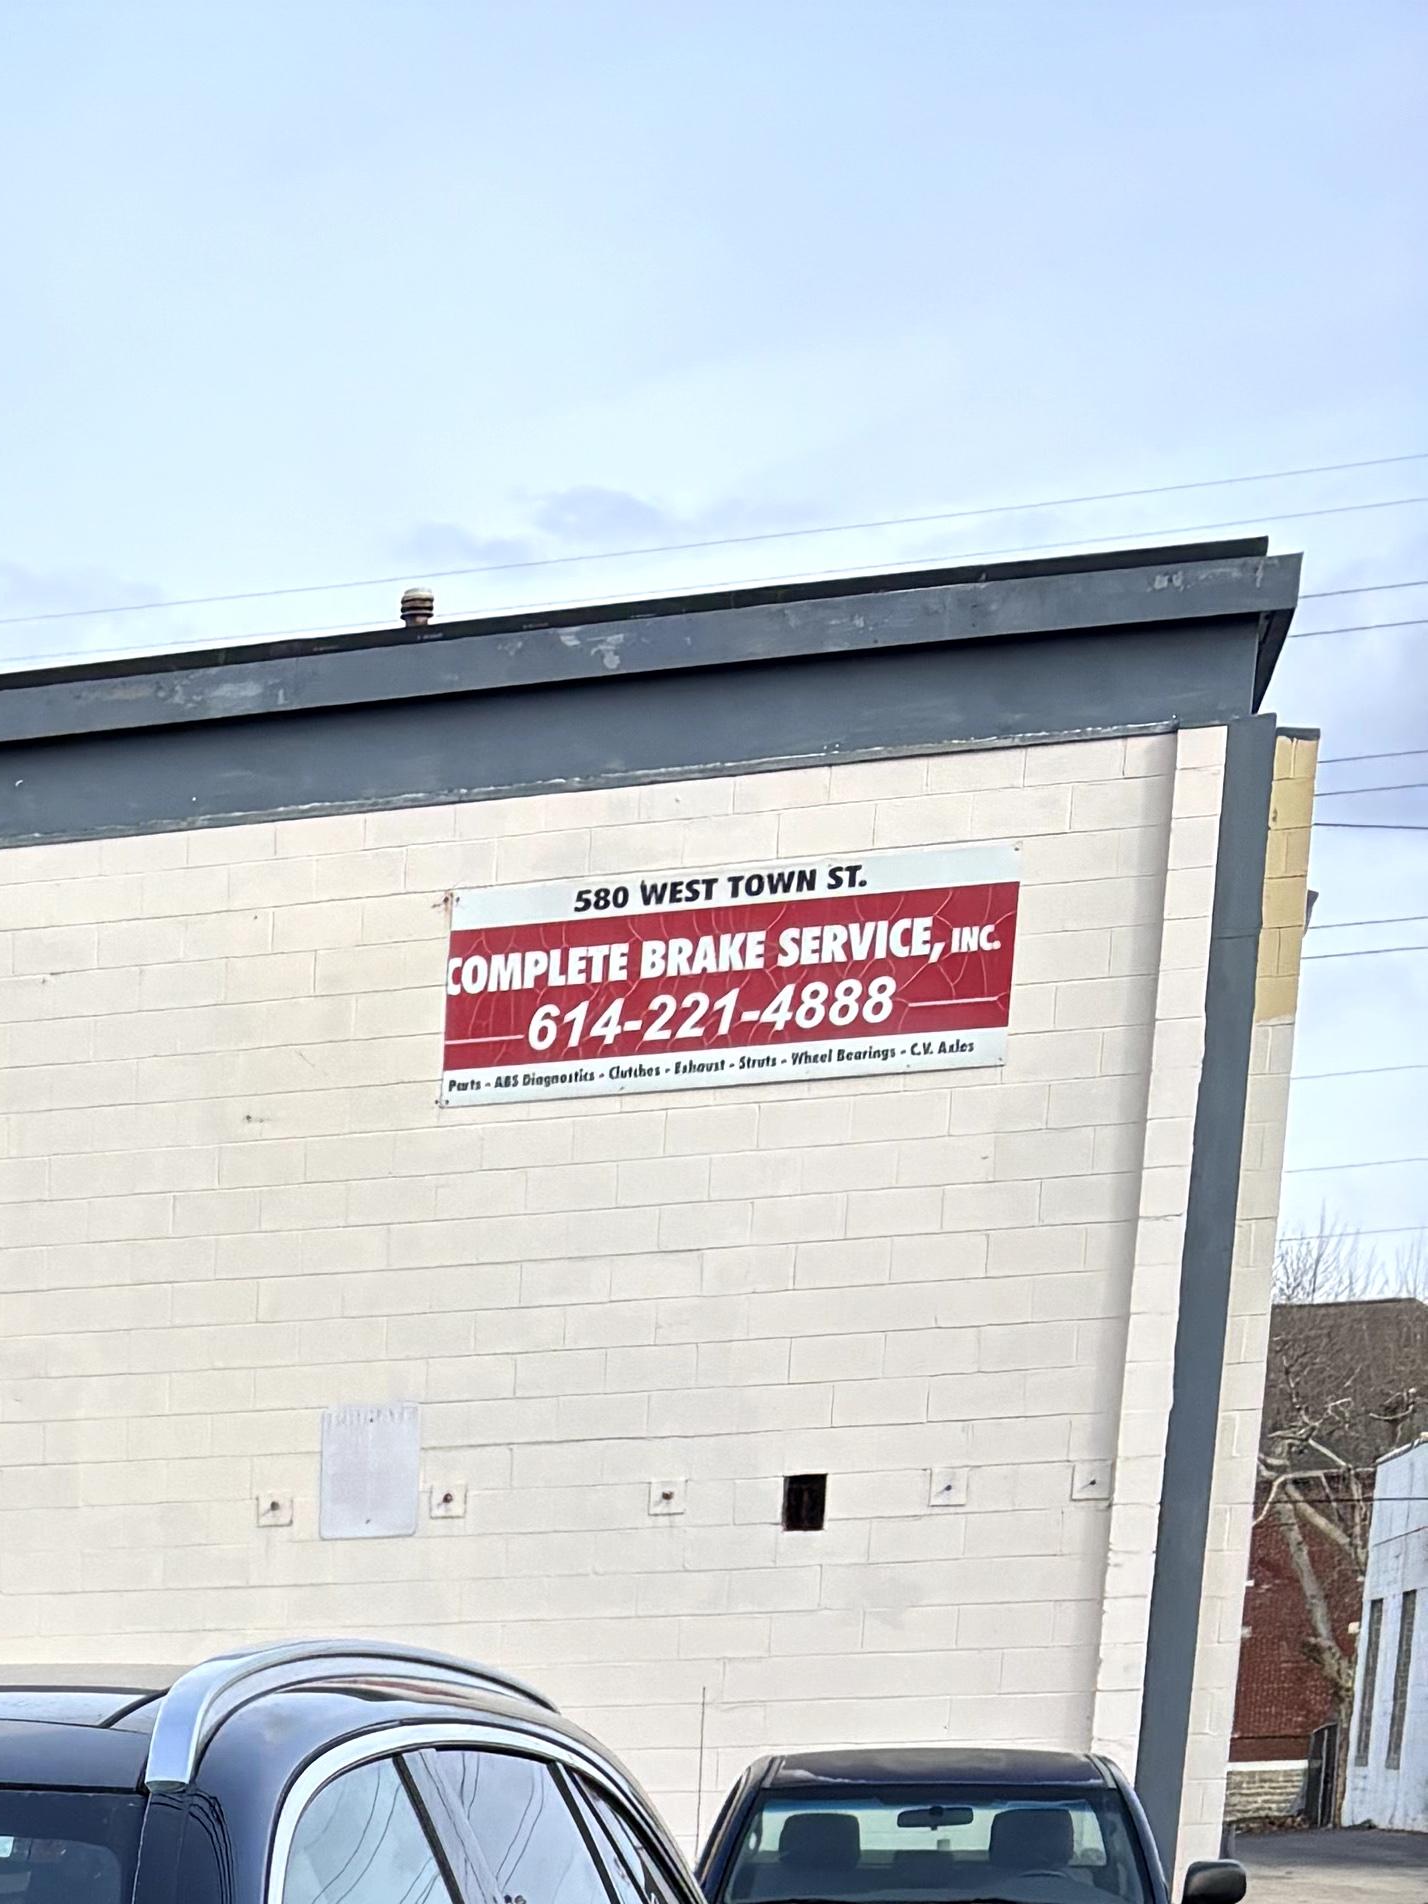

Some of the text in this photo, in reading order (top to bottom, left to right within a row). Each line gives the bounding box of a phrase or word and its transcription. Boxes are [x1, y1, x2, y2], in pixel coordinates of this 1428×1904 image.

[573, 864, 867, 912] 580 WEST TOWN ST.
[447, 916, 1001, 995] COMPLETE BRAKE SERVICE, INC.
[528, 976, 896, 1050] 614-221-4888
[448, 1078, 481, 1092] Parts
[494, 1074, 519, 1088] ABS
[522, 1068, 594, 1087] Diagnostics
[609, 1064, 660, 1080] Clutches
[674, 1059, 725, 1075] Exhaust
[738, 1055, 777, 1070] Struts
[791, 1048, 832, 1065] Wheel
[837, 1045, 896, 1062] Bearings
[937, 1038, 975, 1054] Axles
